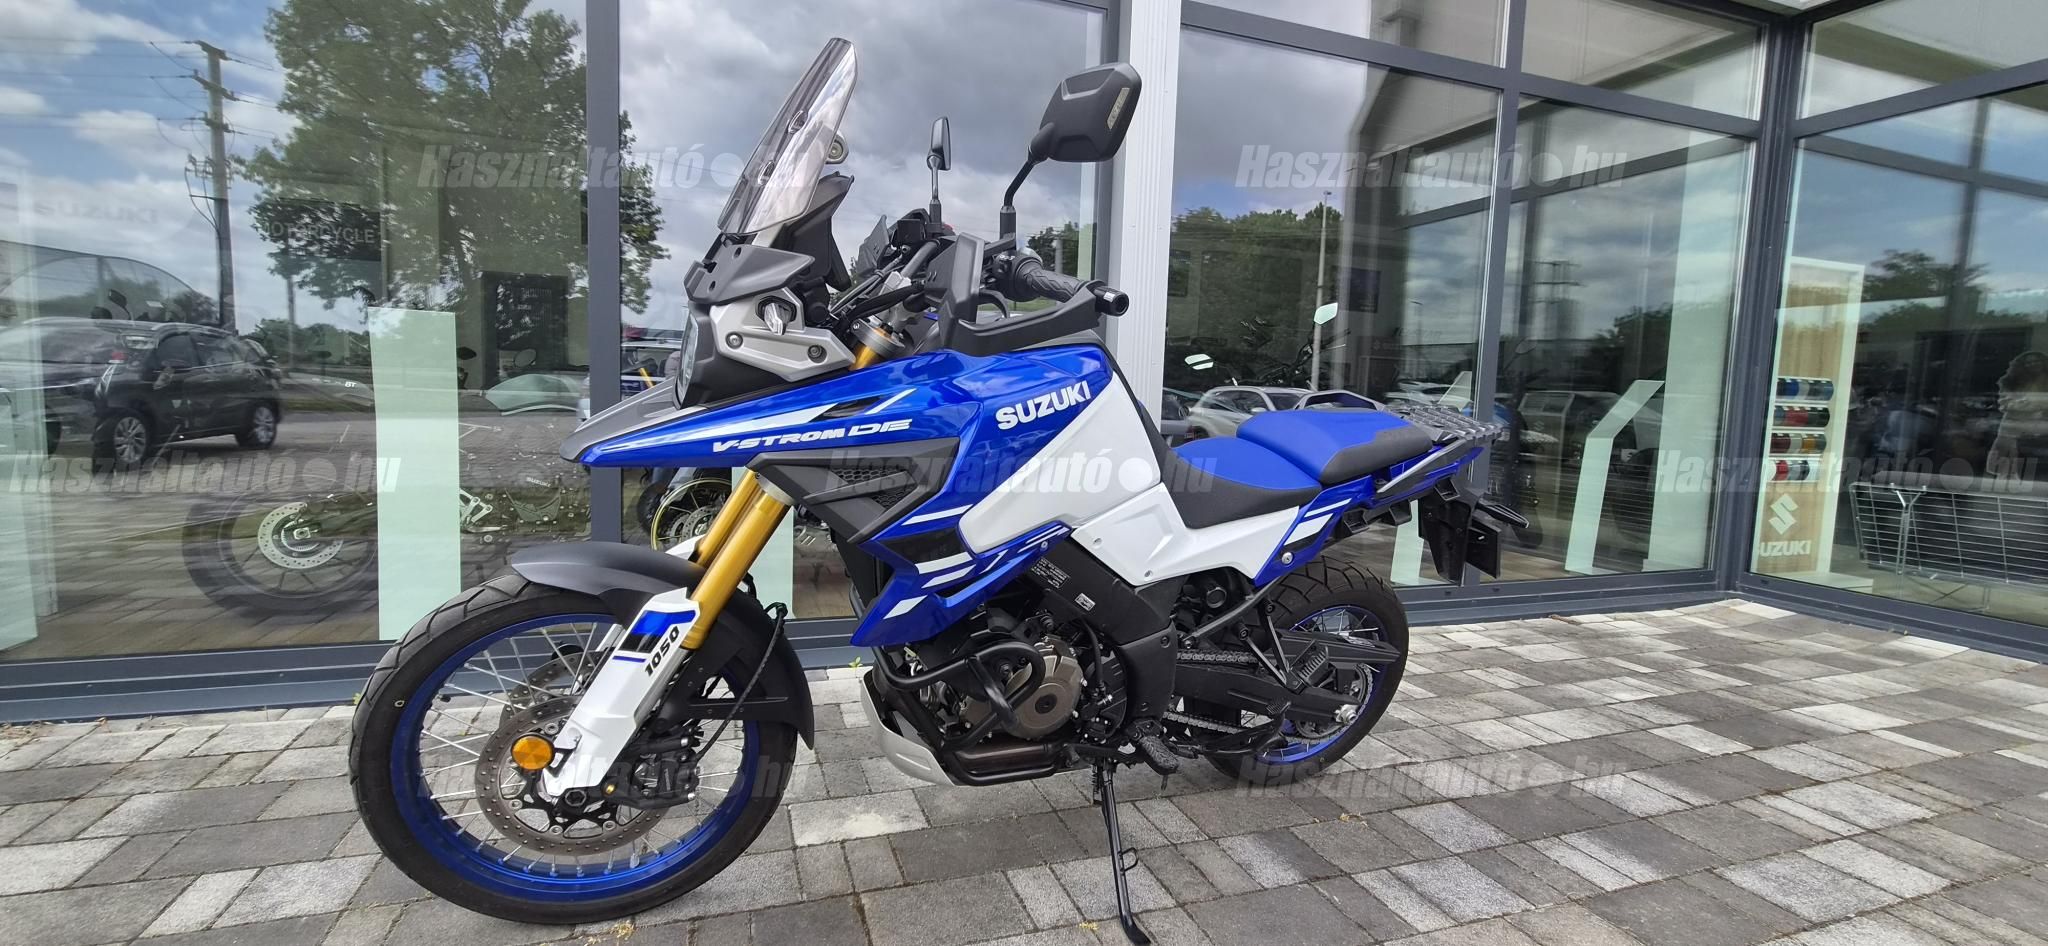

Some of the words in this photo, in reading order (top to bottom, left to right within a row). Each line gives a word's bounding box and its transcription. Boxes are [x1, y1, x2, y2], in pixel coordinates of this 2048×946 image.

[995, 380, 1091, 430] SUZUKI
[713, 428, 846, 453] V-STROM
[1757, 540, 1812, 557] UZUKI
[644, 625, 680, 677] 1050
